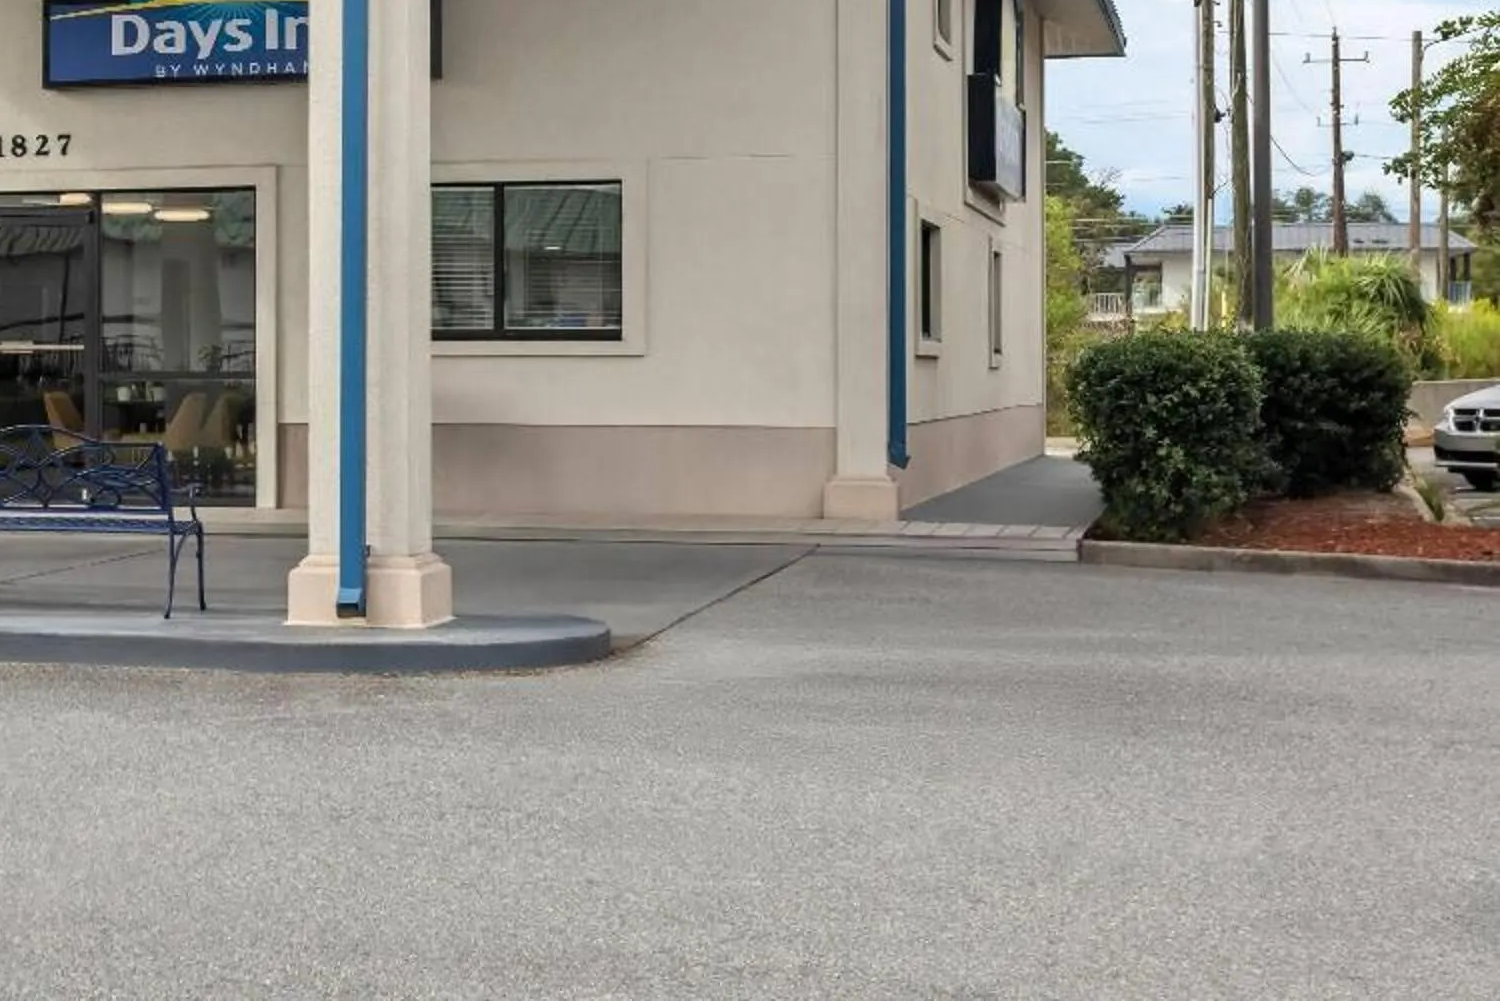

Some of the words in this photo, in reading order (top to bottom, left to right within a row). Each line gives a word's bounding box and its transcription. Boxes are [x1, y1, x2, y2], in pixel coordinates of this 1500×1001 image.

[111, 13, 253, 59] Days
[265, 9, 309, 50] In
[154, 63, 182, 78] BY
